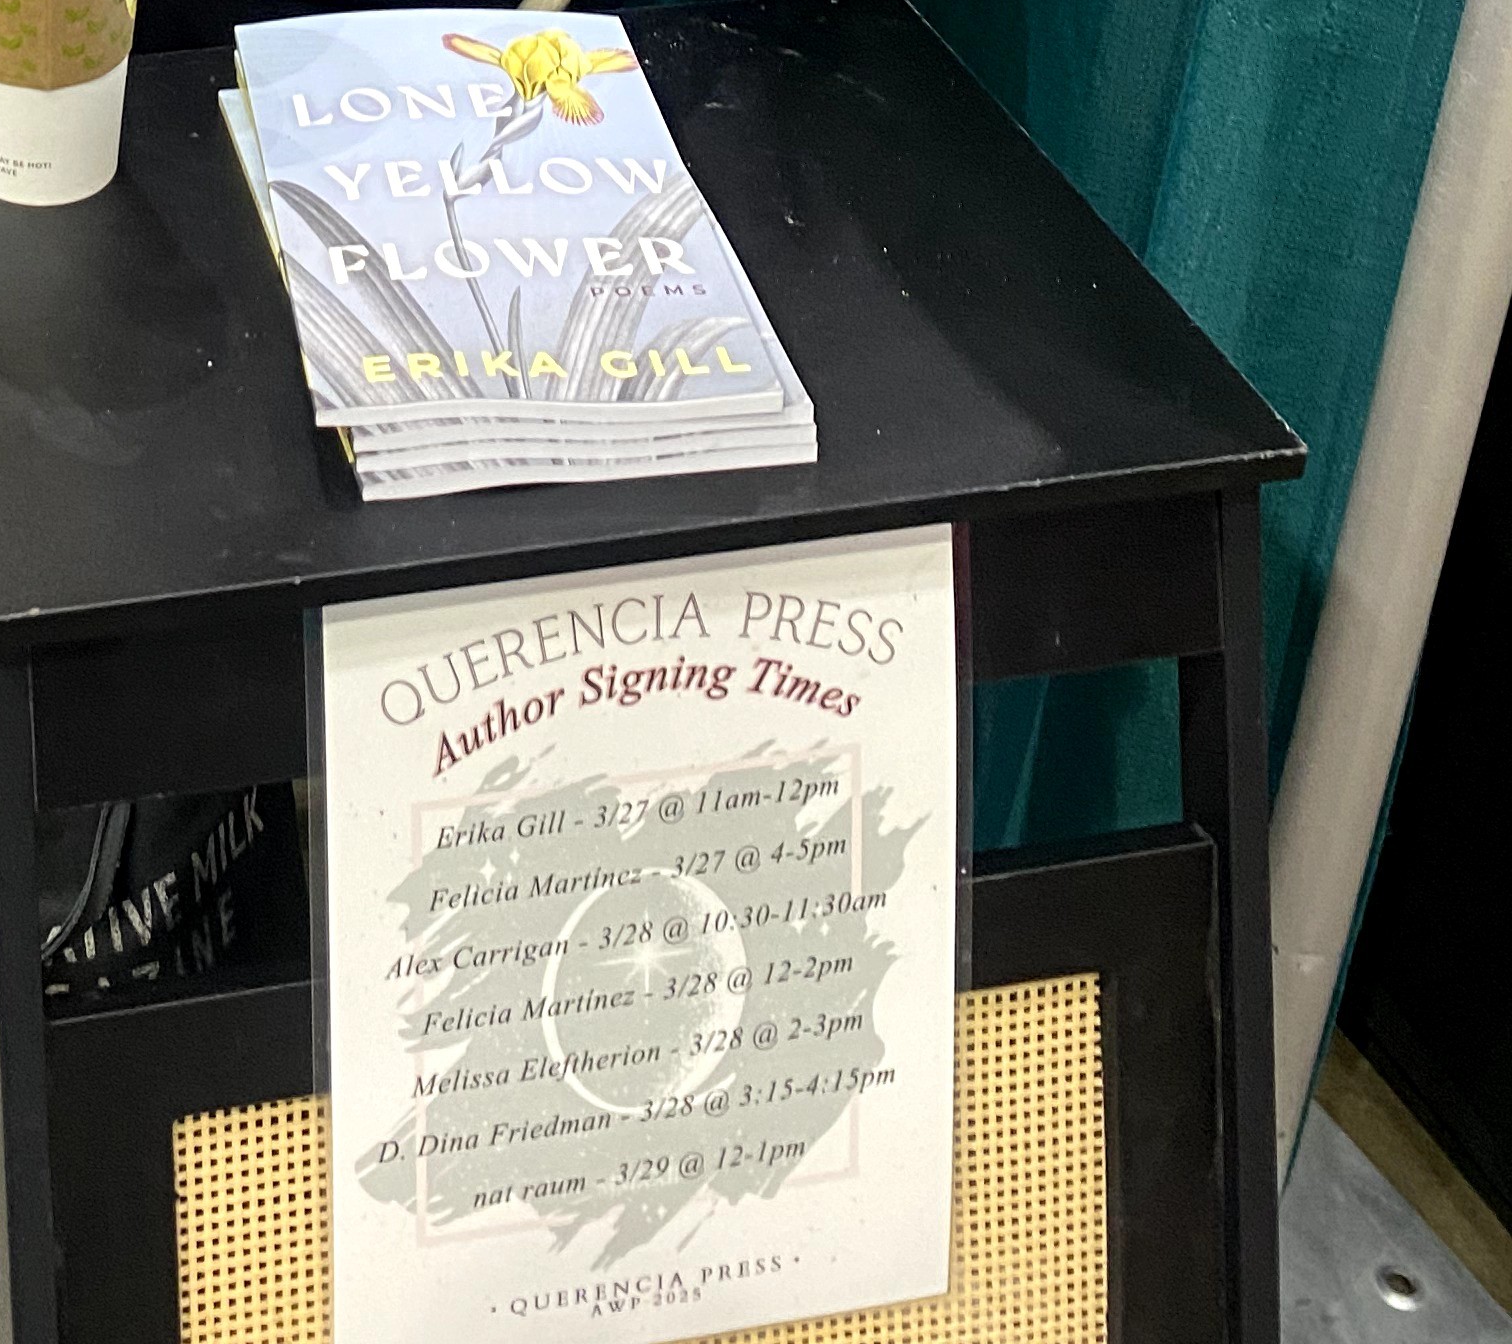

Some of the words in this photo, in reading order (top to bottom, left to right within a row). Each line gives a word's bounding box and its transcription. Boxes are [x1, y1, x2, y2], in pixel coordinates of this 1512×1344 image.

[292, 81, 513, 127] LONE
[323, 156, 667, 201] YELLOW
[327, 236, 696, 285] FLOWER
[590, 283, 707, 298] POEMS
[363, 349, 567, 383] ERIKA
[600, 346, 751, 378] GILL
[381, 591, 710, 728] QUERENCIA
[738, 591, 904, 666] PRESS
[432, 687, 566, 779] Author
[579, 655, 736, 710] Signing
[746, 657, 863, 719] Times
[190, 785, 263, 900] MILK
[436, 822, 506, 849] Erika
[517, 810, 565, 838] Gill
[593, 799, 649, 830] 3/27
[696, 774, 841, 816] 11am-12pm
[429, 883, 521, 913] Felicia
[529, 865, 643, 898] Martínez
[674, 846, 725, 880] 3/27
[770, 835, 847, 865] 4-5pm
[384, 954, 443, 982] Alex
[452, 937, 570, 972] Carrigan
[598, 921, 654, 951] 3/28
[701, 890, 887, 936] 10:30-11:30am
[420, 1007, 512, 1037] Felicia
[520, 988, 636, 1020] Martínez
[663, 972, 718, 1002] 3/28
[764, 955, 854, 987] 12-2pm
[411, 1067, 509, 1100] Melissa
[519, 1045, 661, 1083] Eleftherion
[690, 1028, 744, 1057] 3/28
[788, 1012, 864, 1045] 2-3pm
[377, 1142, 406, 1164] D.
[417, 1130, 479, 1159] Dina
[488, 1111, 612, 1146] Friedman
[640, 1094, 695, 1123] 3/28
[739, 1064, 896, 1107] 3:15-4:15pm
[472, 1187, 514, 1209] nat
[522, 1173, 586, 1199] raum
[615, 1157, 669, 1186] 3/29
[716, 1137, 806, 1171] 12-1pm
[510, 1271, 684, 1315] QUERENCIA
[701, 1254, 782, 1285] PRESS
[592, 1297, 641, 1317] AWP
